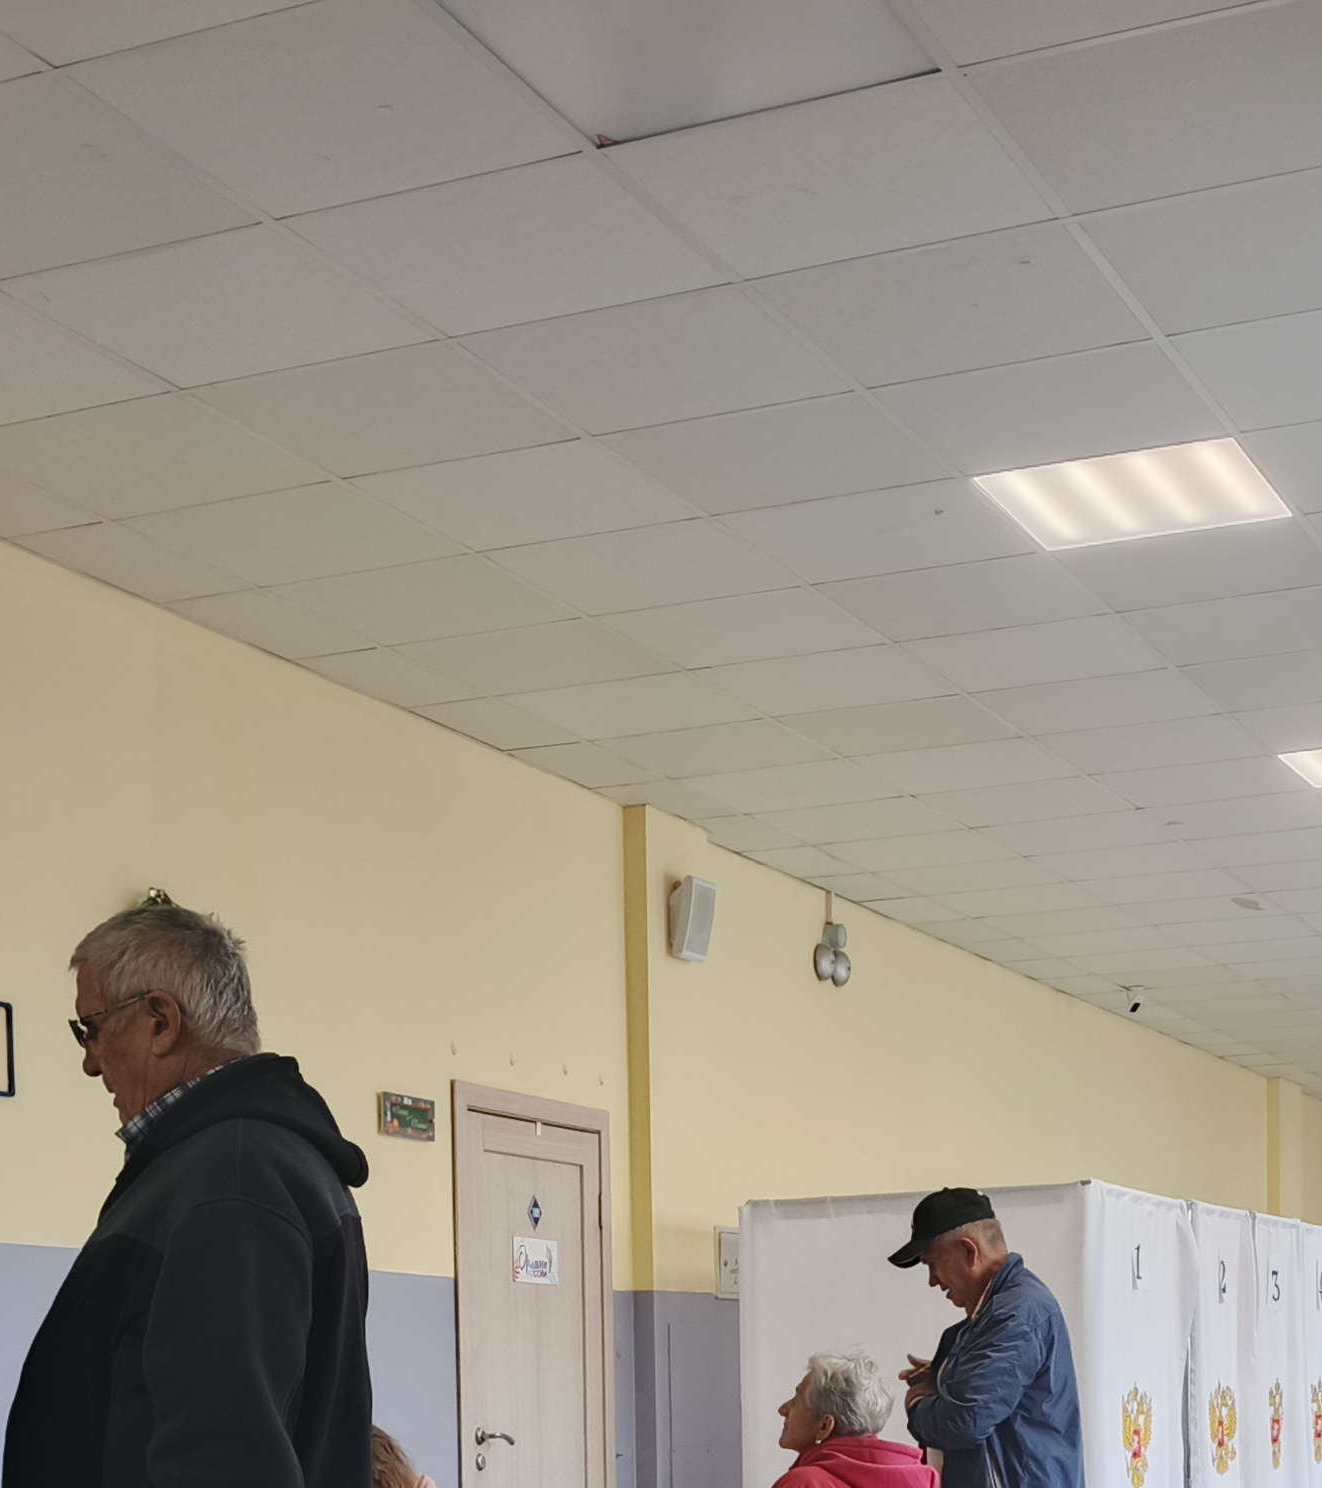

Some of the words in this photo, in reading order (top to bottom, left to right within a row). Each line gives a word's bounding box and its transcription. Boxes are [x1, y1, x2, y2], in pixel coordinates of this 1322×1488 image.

[1134, 1243, 1142, 1280] 1
[1220, 1260, 1226, 1294] 2
[1271, 1270, 1281, 1302] 3
